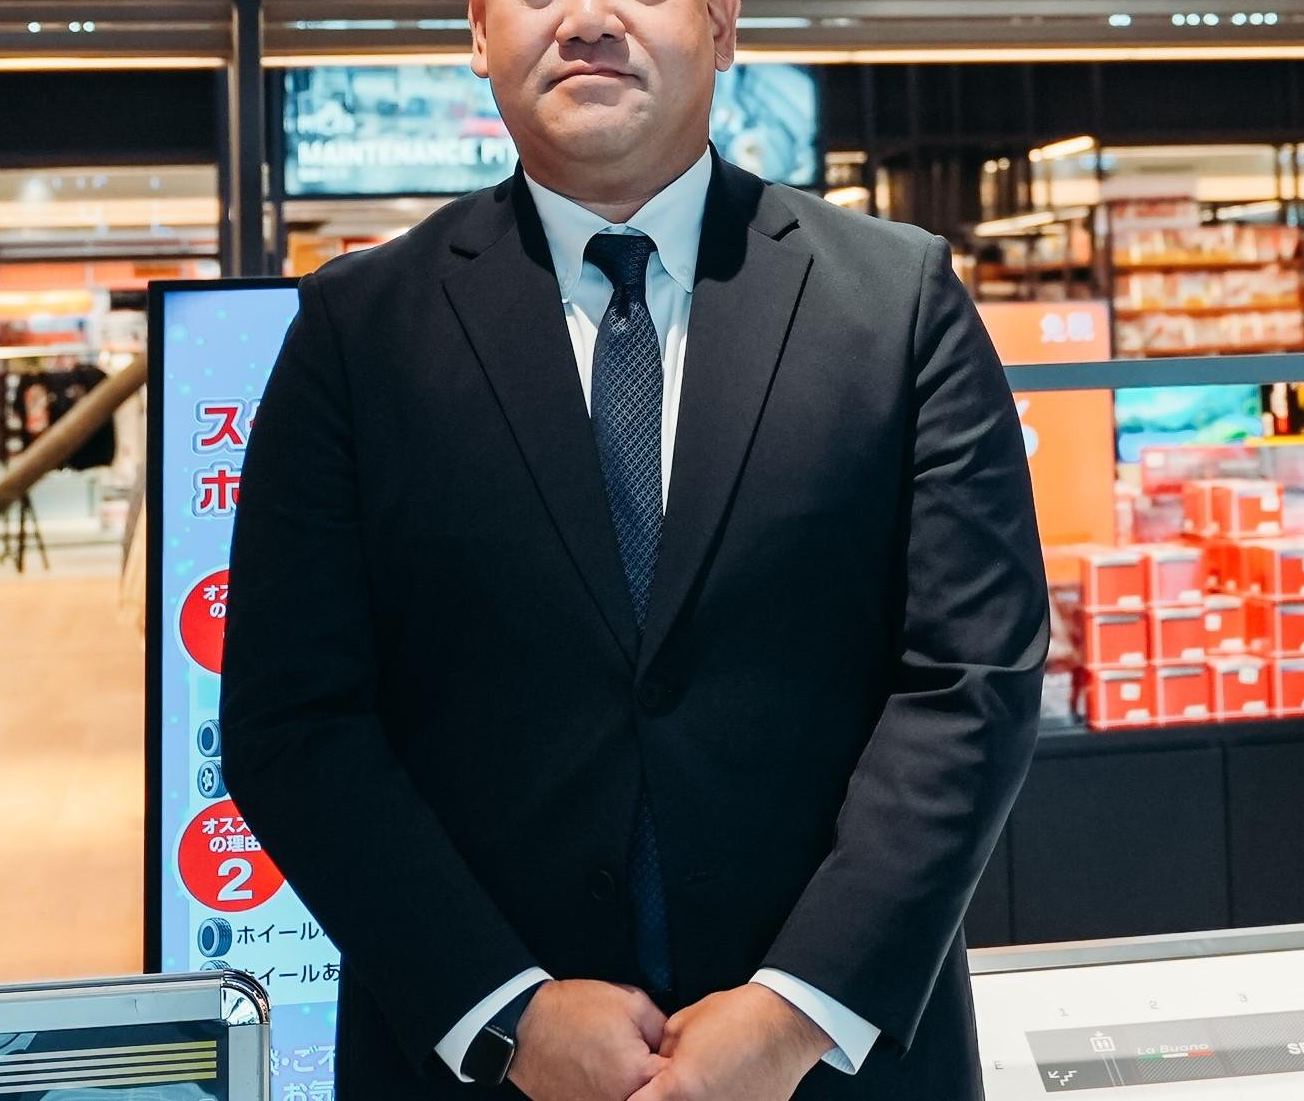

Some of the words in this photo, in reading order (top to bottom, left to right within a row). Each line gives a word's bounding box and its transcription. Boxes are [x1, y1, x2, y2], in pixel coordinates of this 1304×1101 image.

[200, 406, 262, 447] ス
[217, 857, 253, 901] 2
[236, 921, 329, 945] ホイール
